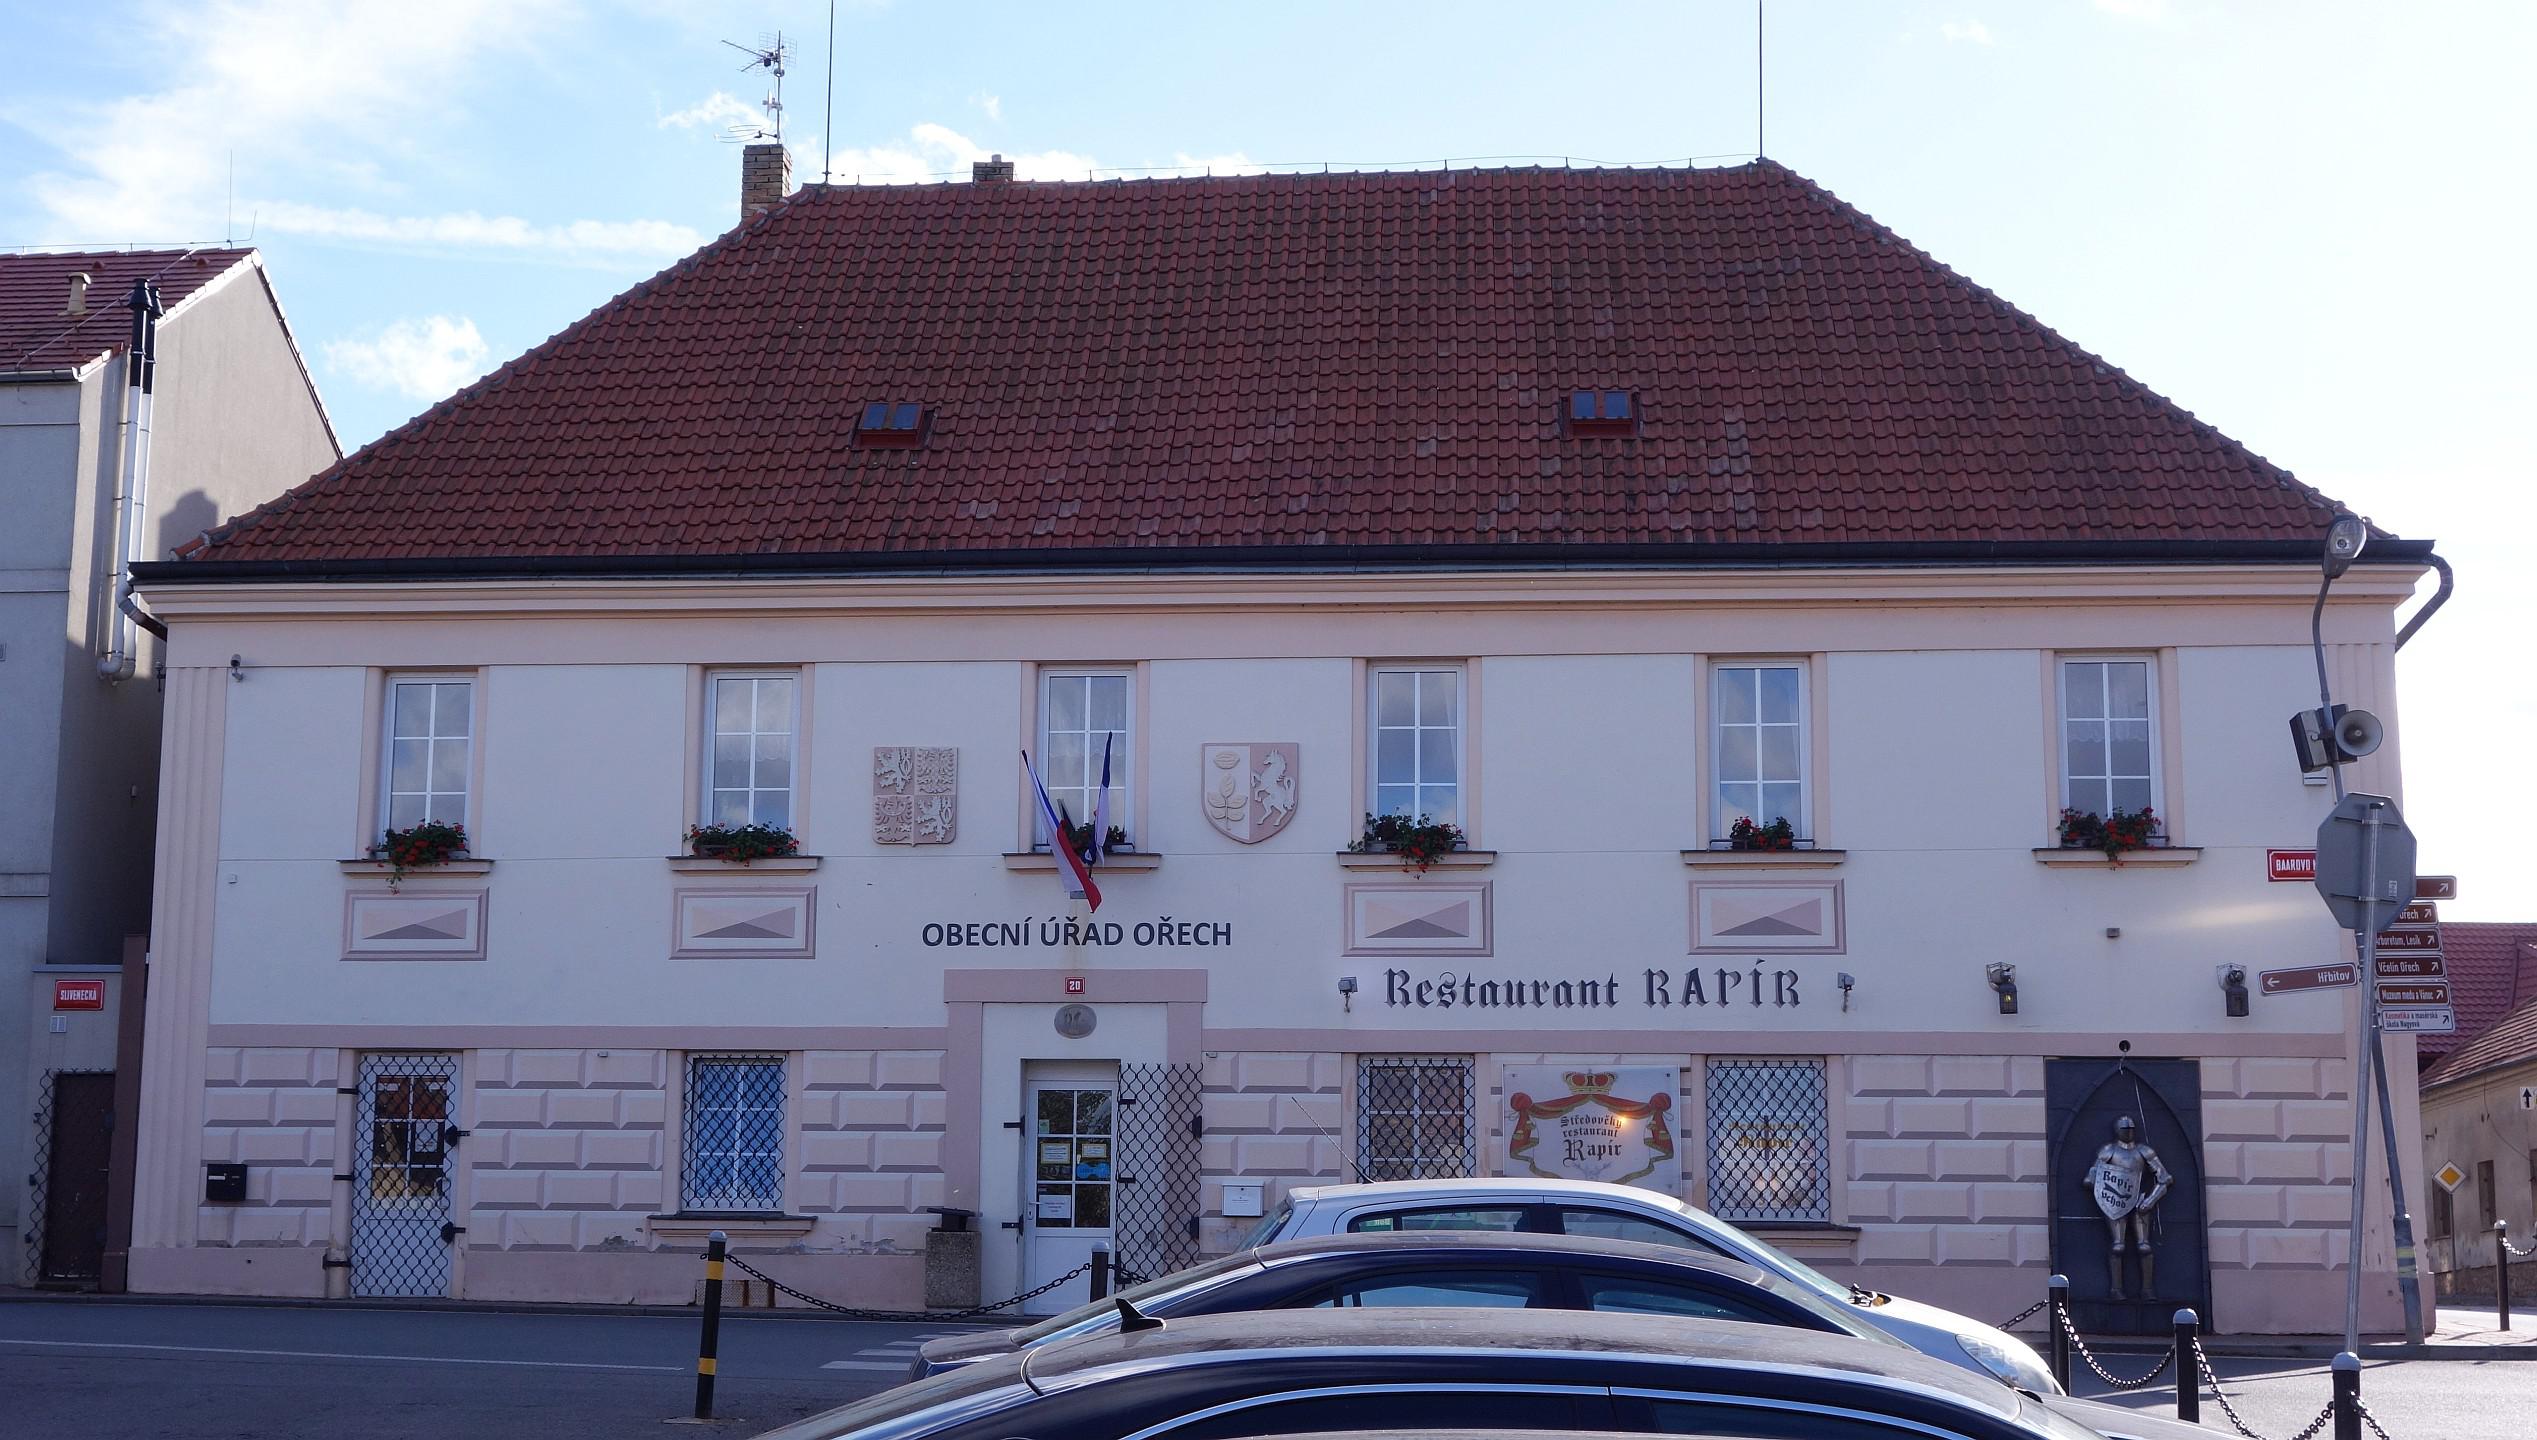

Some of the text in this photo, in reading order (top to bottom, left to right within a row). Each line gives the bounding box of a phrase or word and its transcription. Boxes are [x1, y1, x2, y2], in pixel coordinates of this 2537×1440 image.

[2275, 858, 2311, 871] BAAROVO
[922, 916, 1232, 947] OBECNÍ ÚŘAD OŘECH
[2400, 961, 2420, 973] Ořech
[1383, 957, 1801, 1009] Restaurant RAPÍR
[2317, 971, 2350, 983] Hřbitov
[1068, 980, 1081, 991] 20
[60, 988, 97, 1001] SLIVENECKÁ
[1562, 1127, 1618, 1137] restaurant
[1562, 1139, 1622, 1167] Rapír
